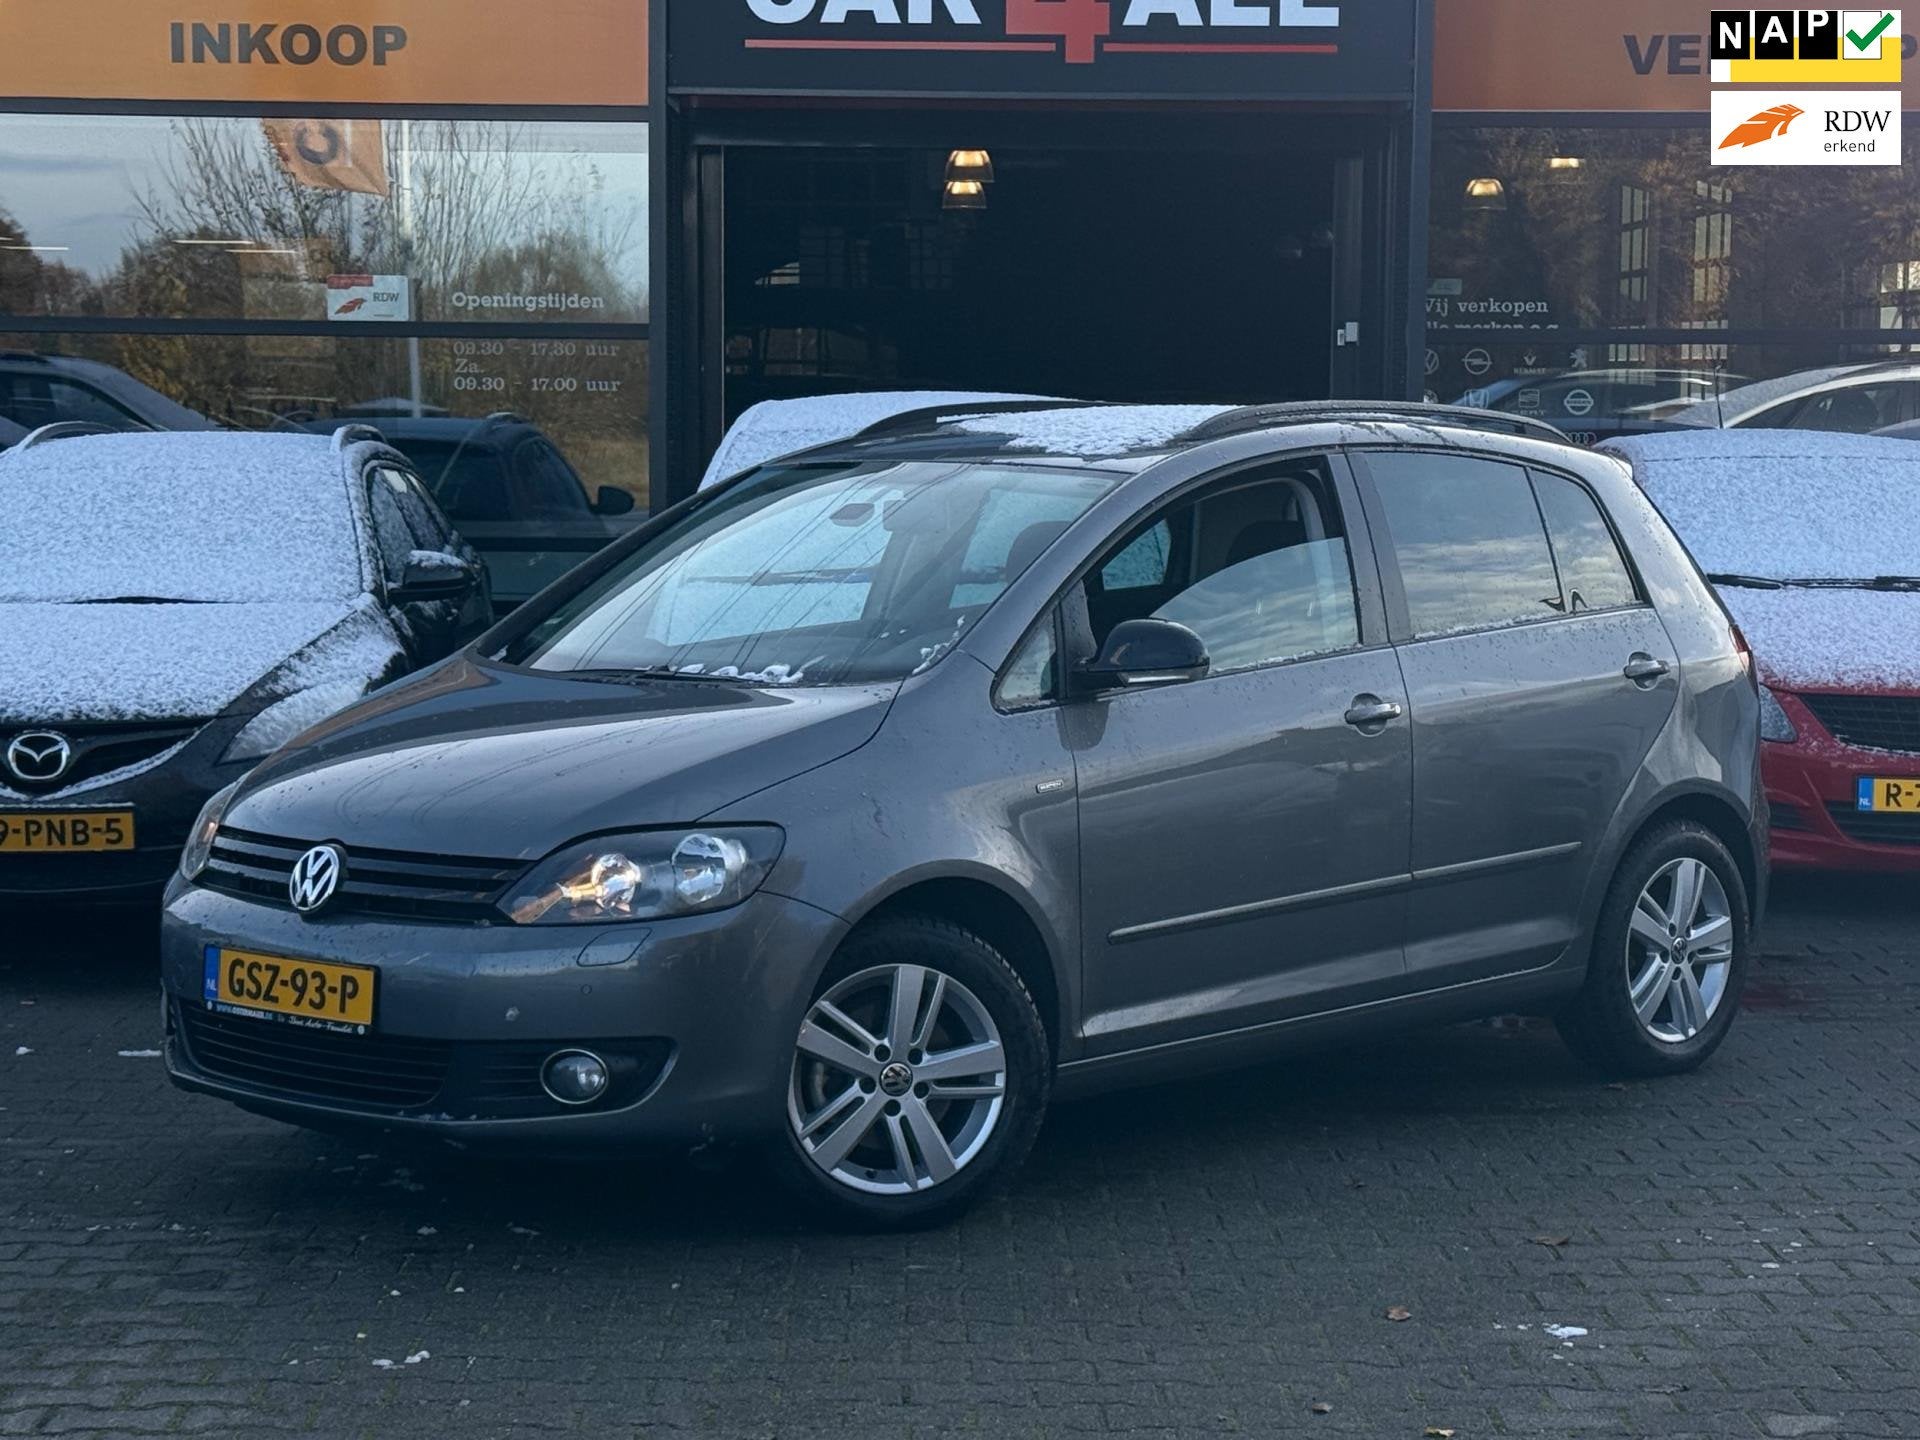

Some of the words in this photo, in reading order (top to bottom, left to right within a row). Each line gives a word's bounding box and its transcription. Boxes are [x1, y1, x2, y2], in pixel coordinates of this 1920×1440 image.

[170, 21, 408, 67] INKOOP
[372, 291, 400, 303] RDW
[452, 292, 604, 311] Openingstijden
[1457, 297, 1549, 317] verkopen
[453, 341, 504, 356] 09.30
[530, 342, 576, 357] 17.30
[585, 344, 621, 357] uur
[454, 358, 485, 374] Za.
[453, 377, 505, 391] 09.30
[531, 378, 577, 392] 17.00
[586, 380, 621, 392] uur
[1859, 797, 1871, 806] NL
[206, 978, 217, 991] NL
[228, 958, 359, 1014] GSZ-93-P
